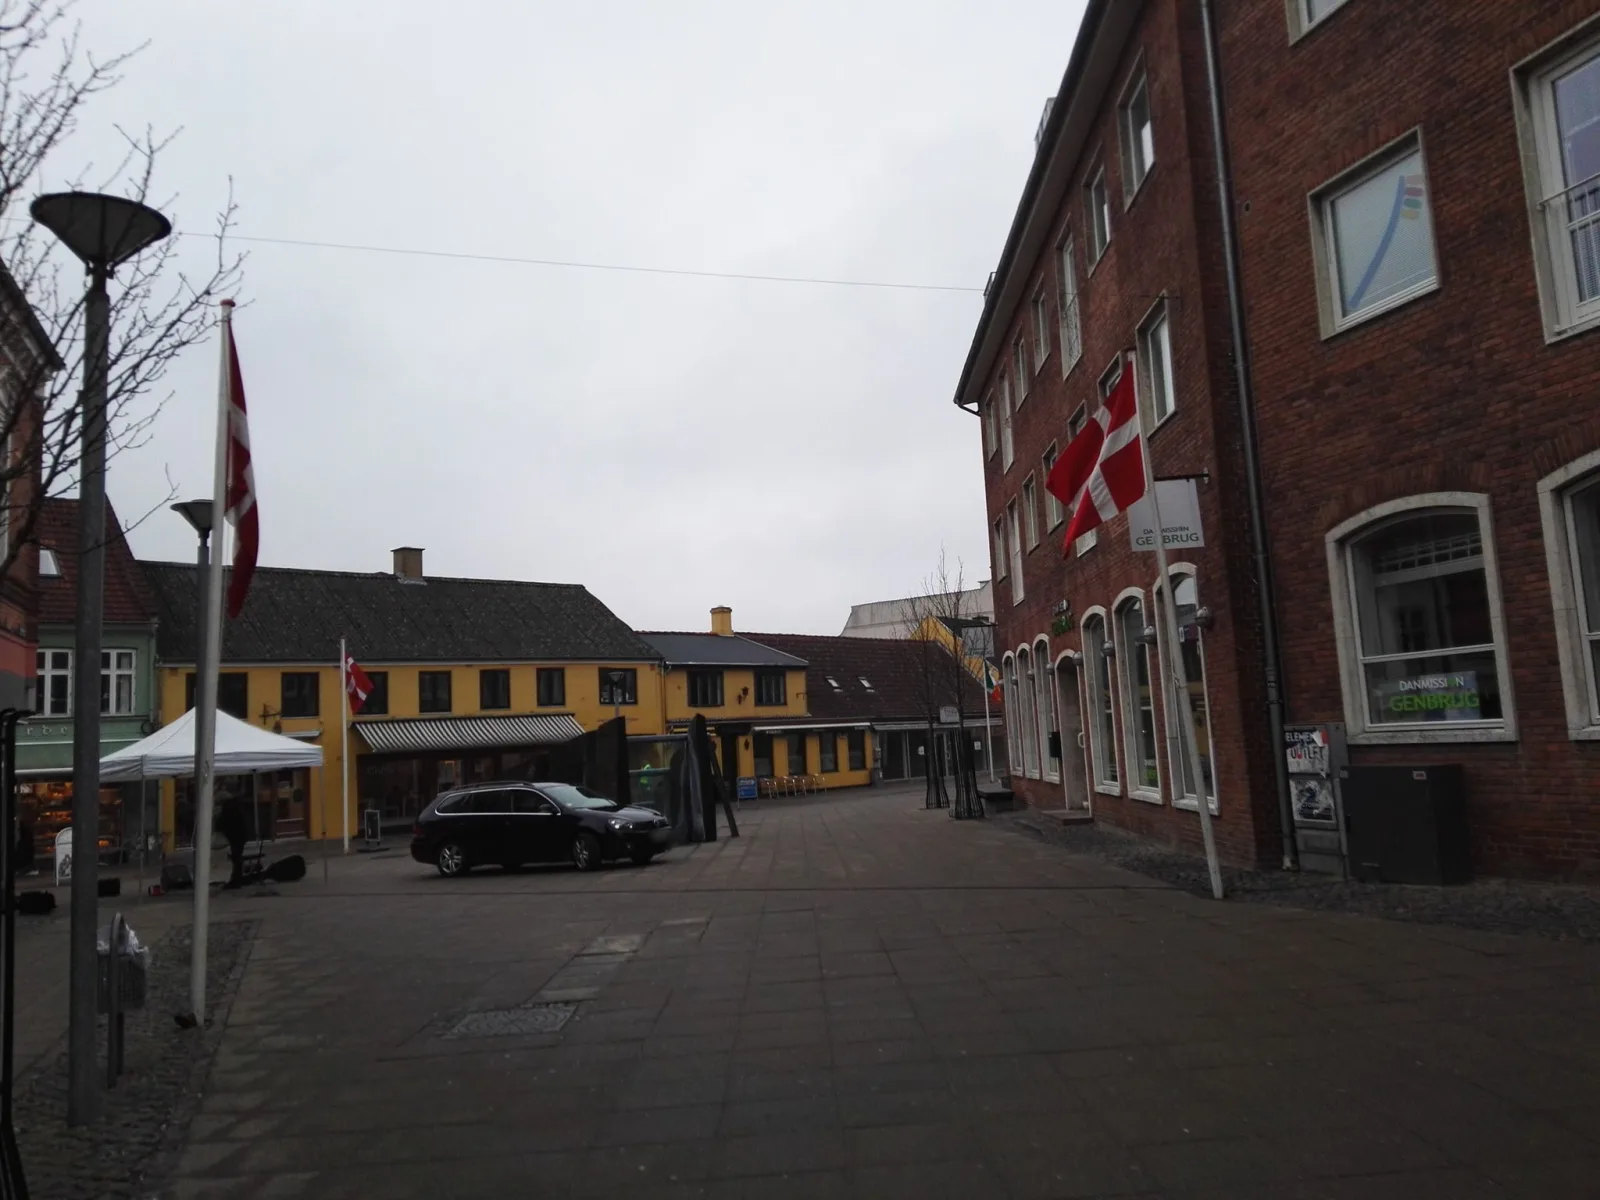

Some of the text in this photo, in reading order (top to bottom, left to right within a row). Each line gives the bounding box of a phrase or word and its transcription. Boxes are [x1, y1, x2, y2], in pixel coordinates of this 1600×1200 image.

[1143, 526, 1188, 535] DAMISSION
[1136, 533, 1199, 546] GEBRUG
[1390, 692, 1480, 712] GENBRUG
